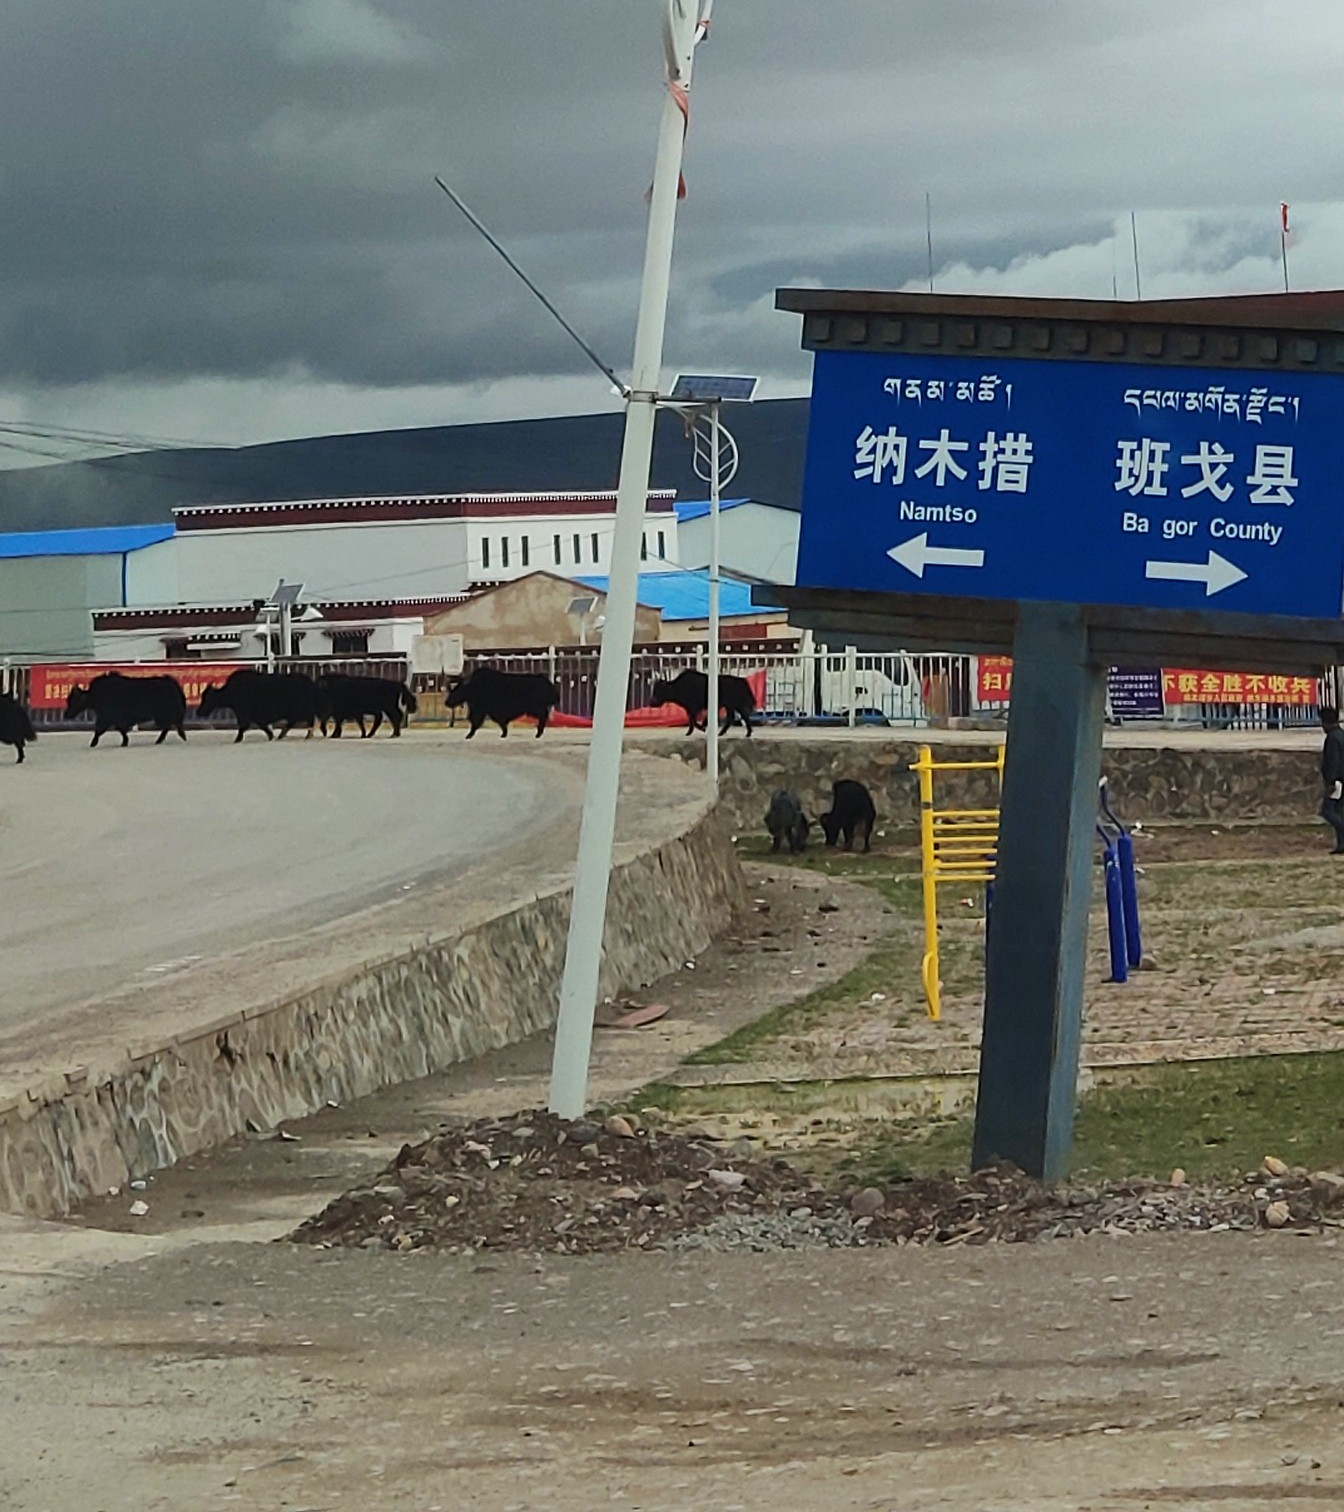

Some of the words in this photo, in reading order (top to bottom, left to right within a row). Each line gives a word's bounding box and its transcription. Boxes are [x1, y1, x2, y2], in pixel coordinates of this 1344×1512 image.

[853, 425, 1034, 494] 纳木措
[1114, 437, 1299, 506] 班戈县
[899, 500, 978, 524] Namtso
[1122, 512, 1150, 534] Ba
[1162, 519, 1198, 539] gor
[1209, 518, 1283, 546] County
